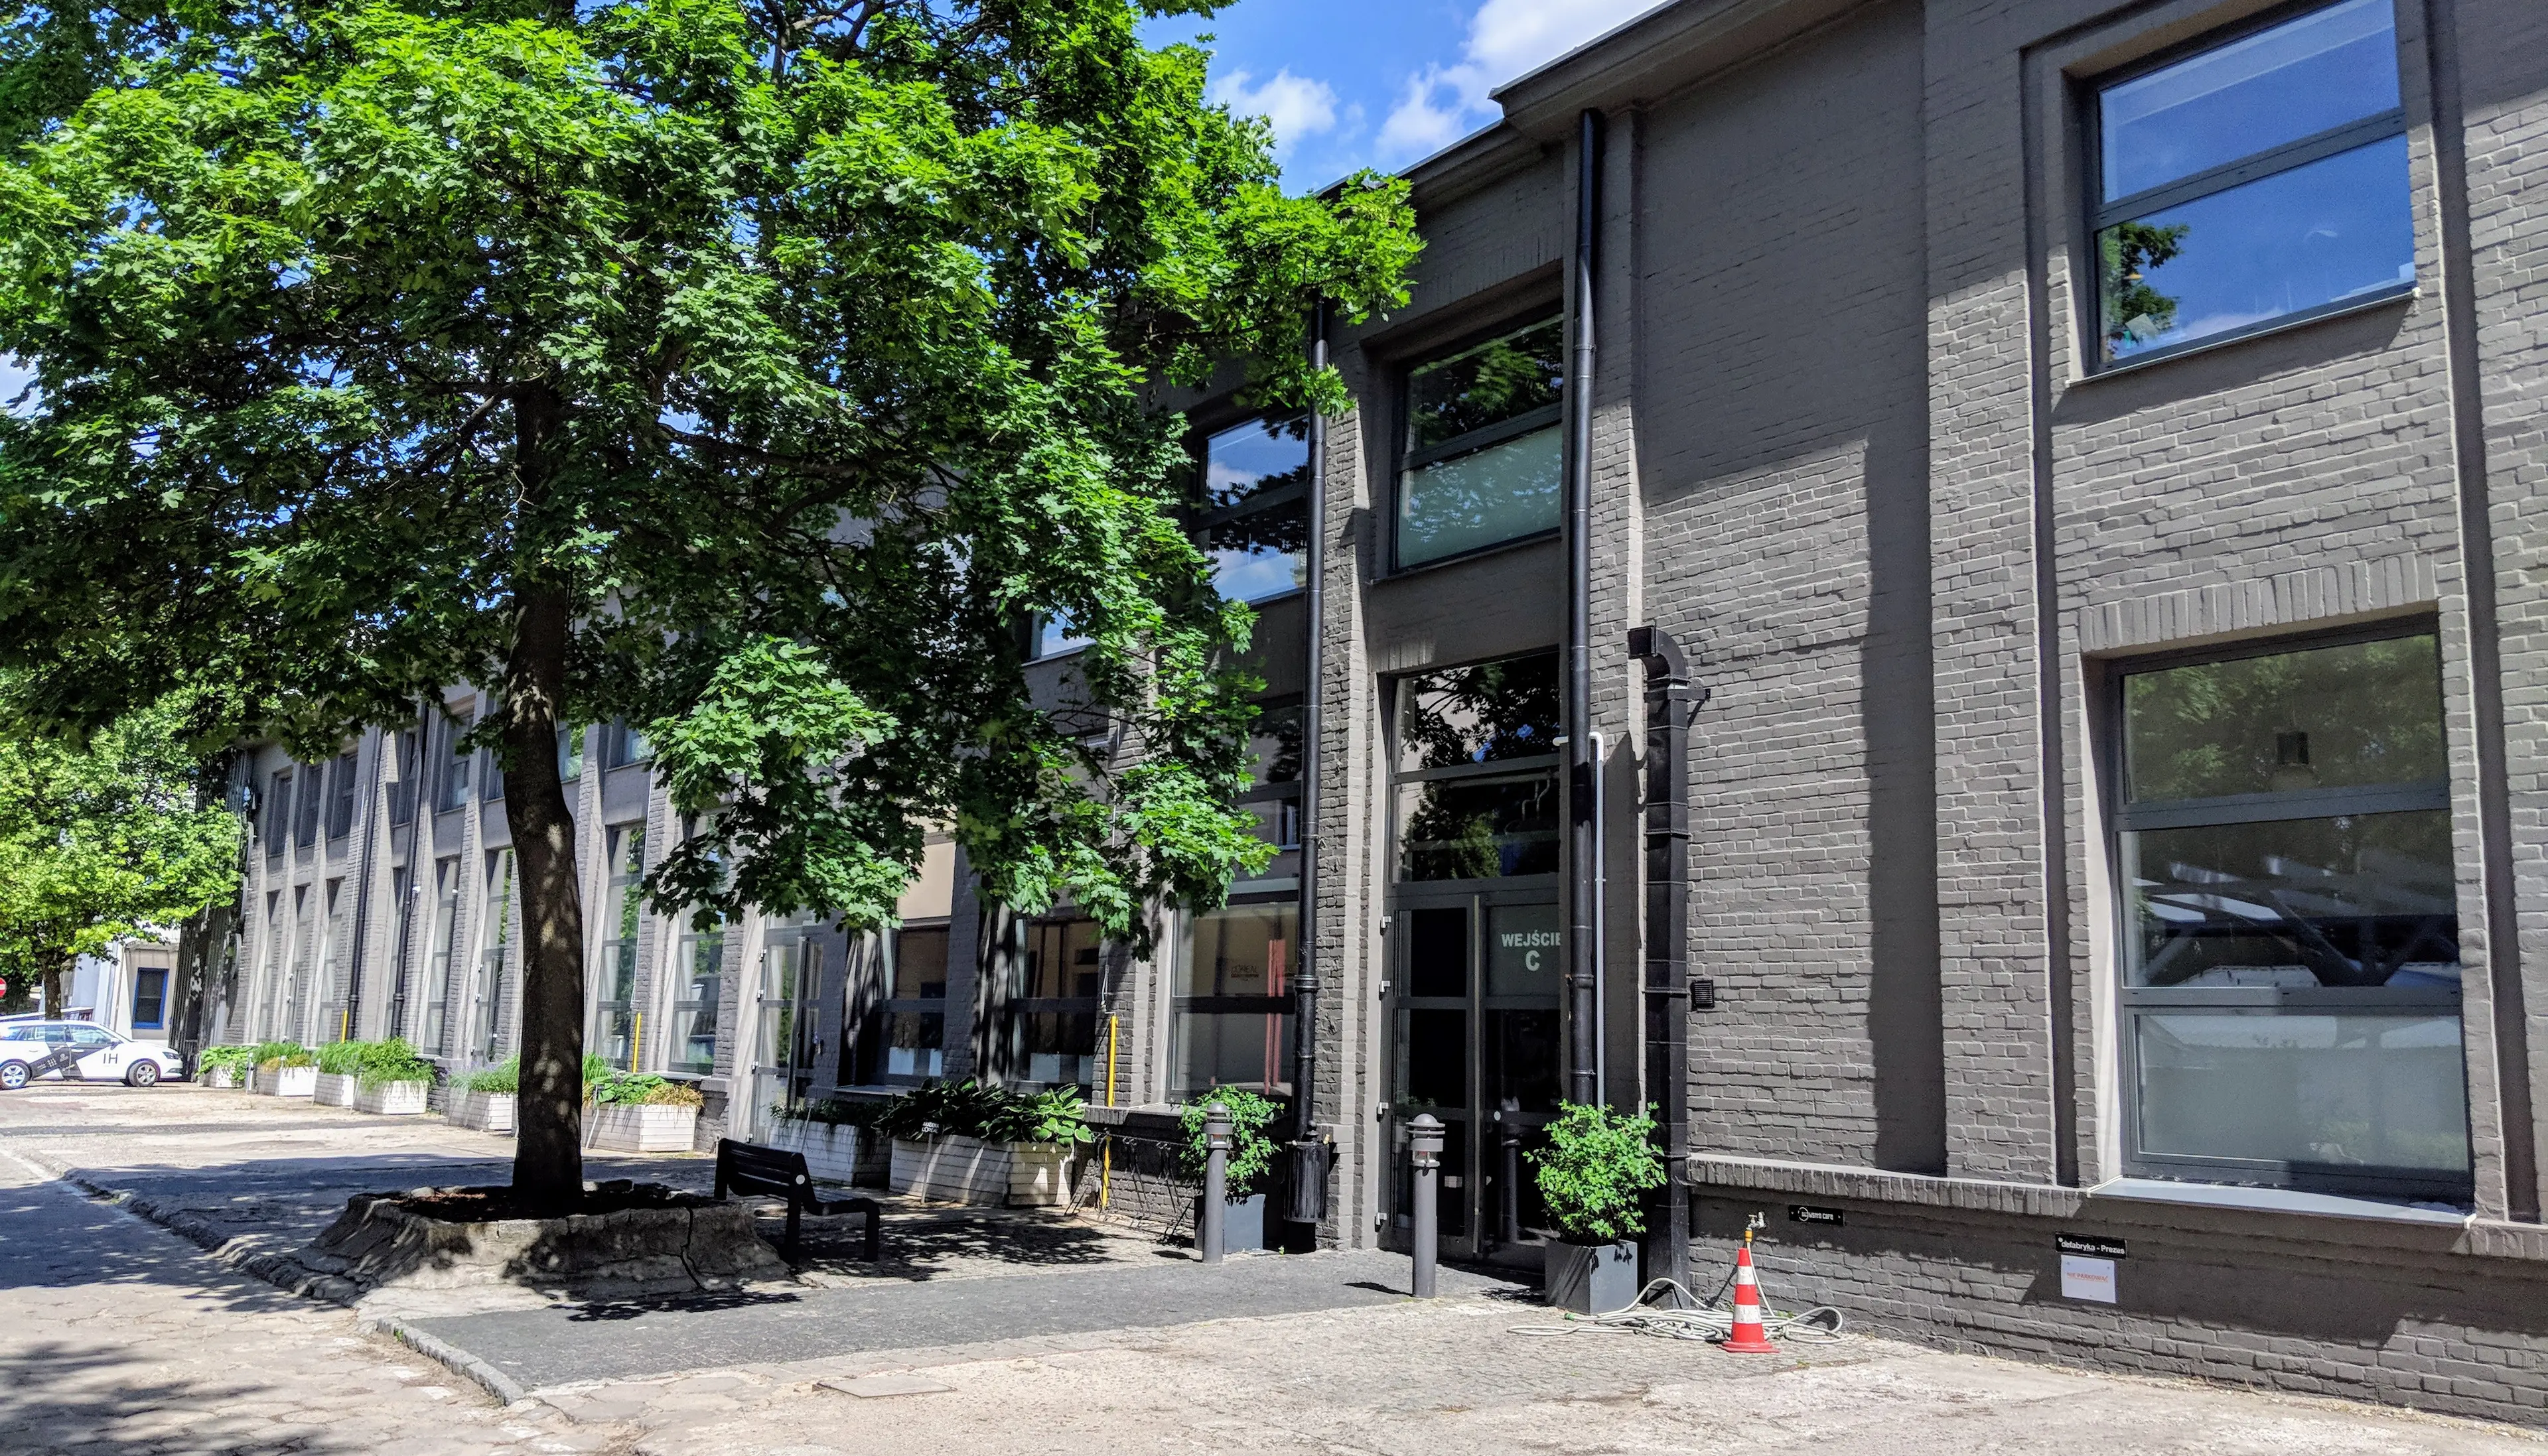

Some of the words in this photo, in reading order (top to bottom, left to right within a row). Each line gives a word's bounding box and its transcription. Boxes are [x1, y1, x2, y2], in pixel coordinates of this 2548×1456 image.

[1501, 929, 1561, 947] WEJŚCIE
[1525, 950, 1540, 971] C
[103, 1053, 118, 1064] IH
